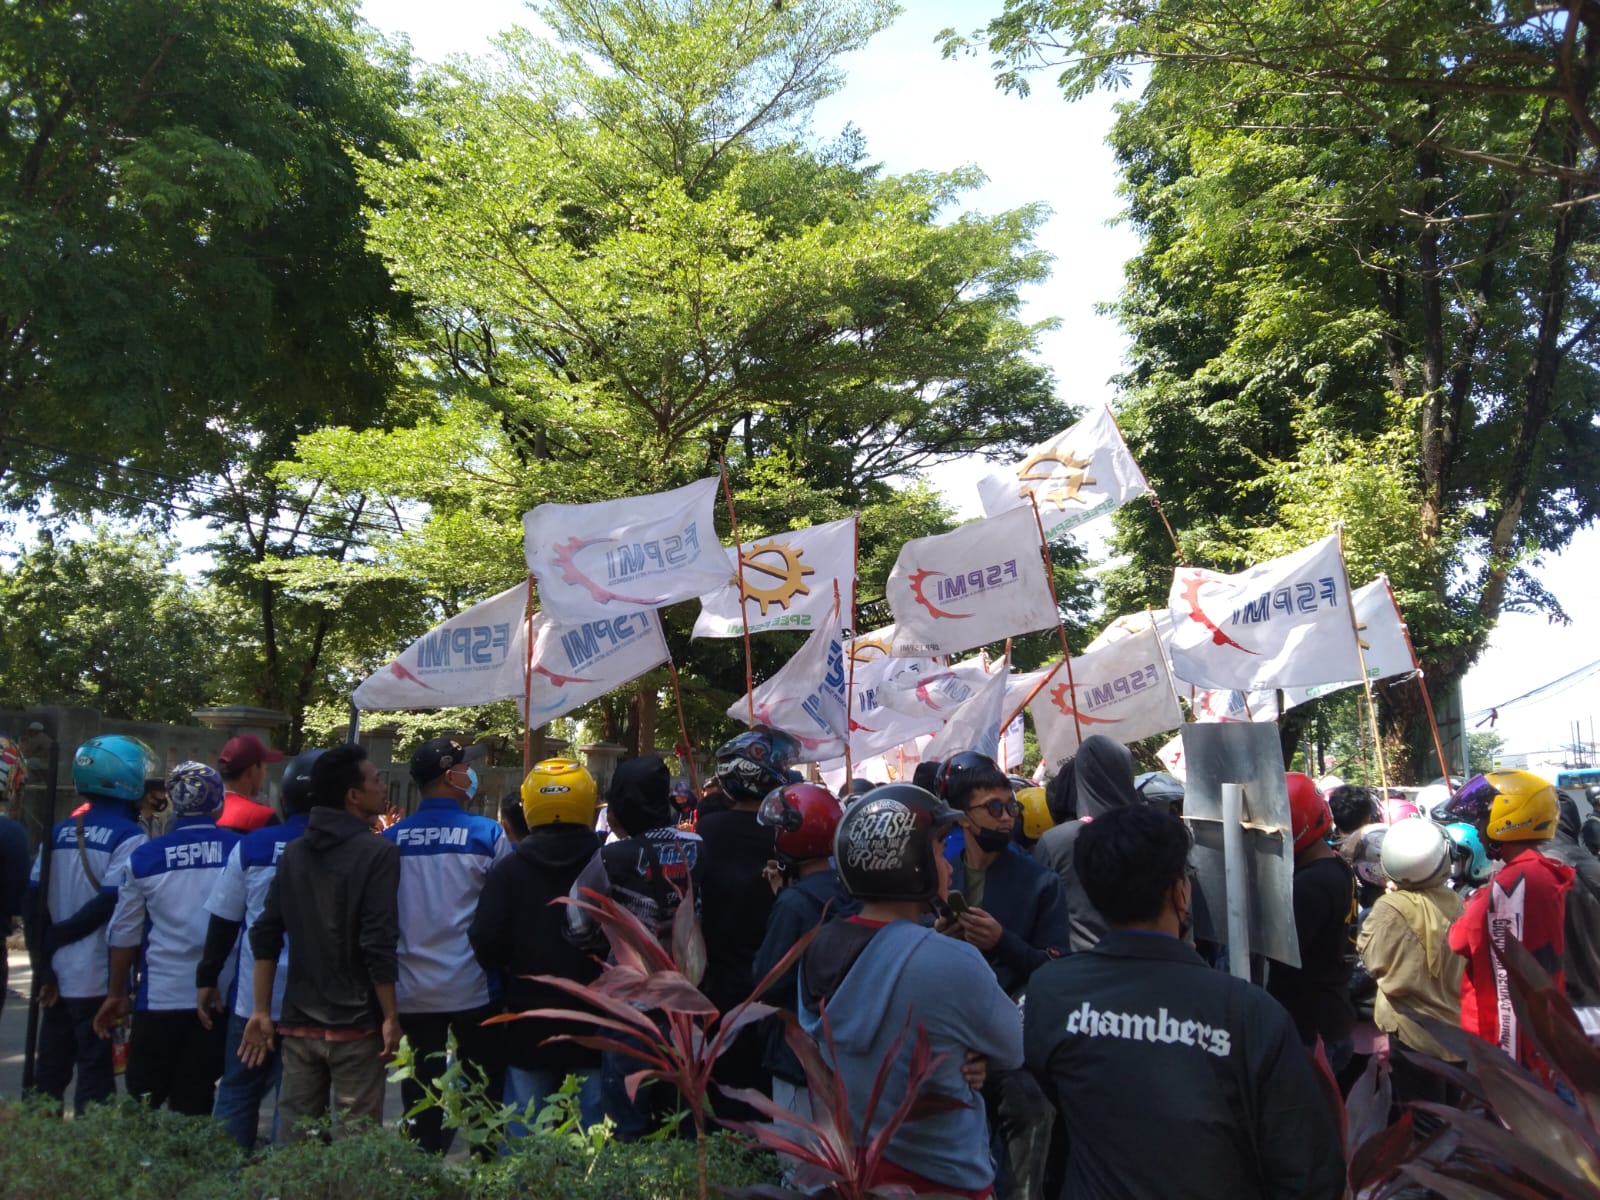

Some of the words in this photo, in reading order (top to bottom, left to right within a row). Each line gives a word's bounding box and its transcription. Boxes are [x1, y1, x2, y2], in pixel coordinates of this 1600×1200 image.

[56, 824, 113, 845] FSPMI
[396, 827, 469, 847] FSPMI
[849, 811, 917, 841] CRASH
[165, 841, 223, 868] FSPMI
[1065, 1001, 1232, 1057] chambers
